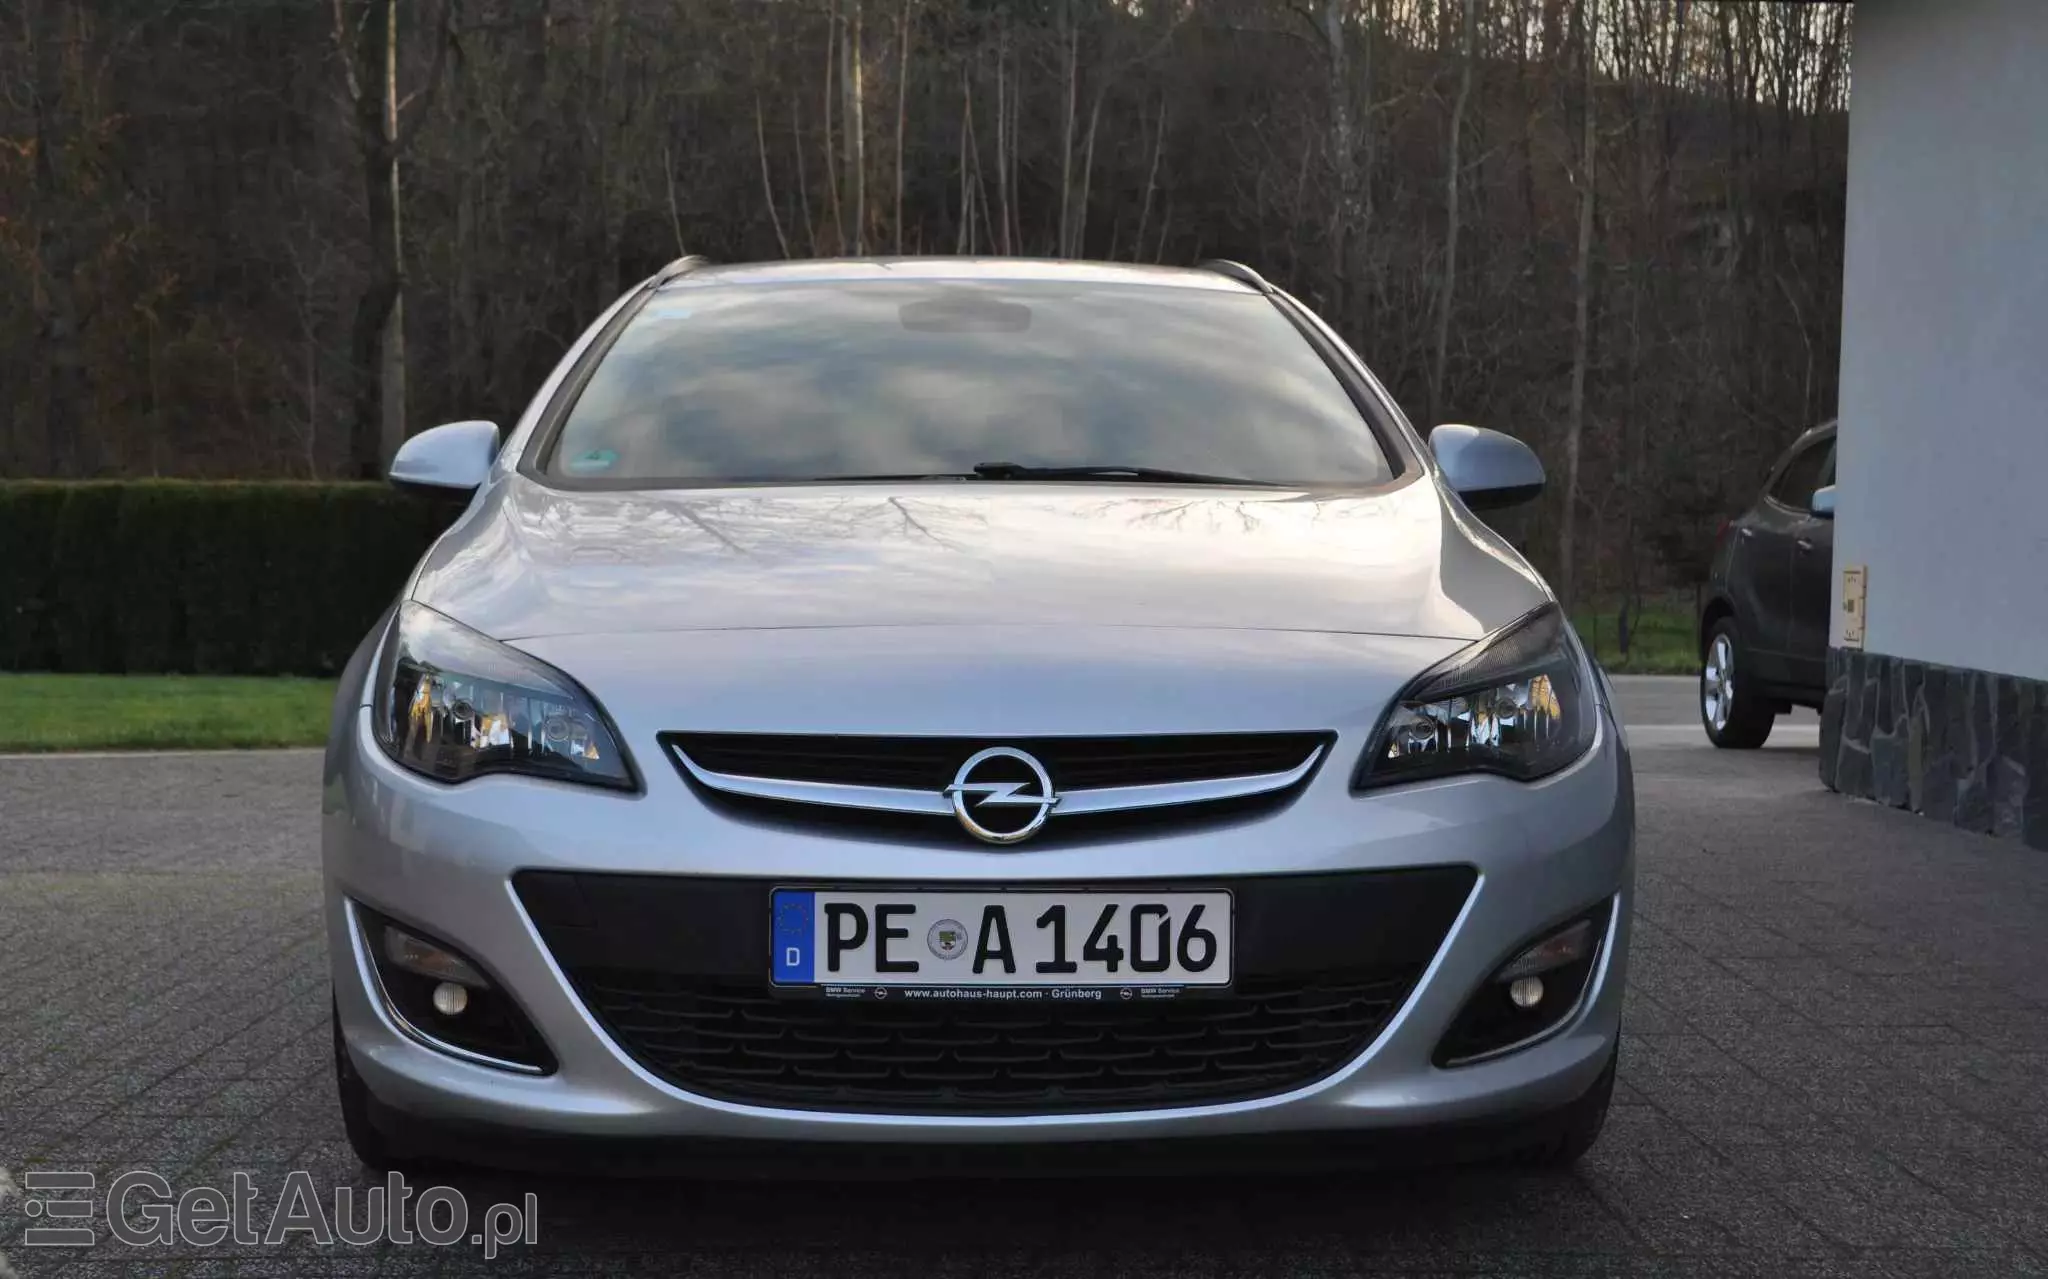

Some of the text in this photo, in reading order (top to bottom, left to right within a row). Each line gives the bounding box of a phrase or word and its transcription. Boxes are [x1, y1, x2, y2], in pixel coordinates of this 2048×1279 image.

[825, 903, 920, 973] PE
[972, 904, 1016, 974] A
[1036, 904, 1218, 973] 1406
[786, 947, 800, 966] D
[904, 988, 1102, 1001] www.autohaus-haupt.com Grünberg
